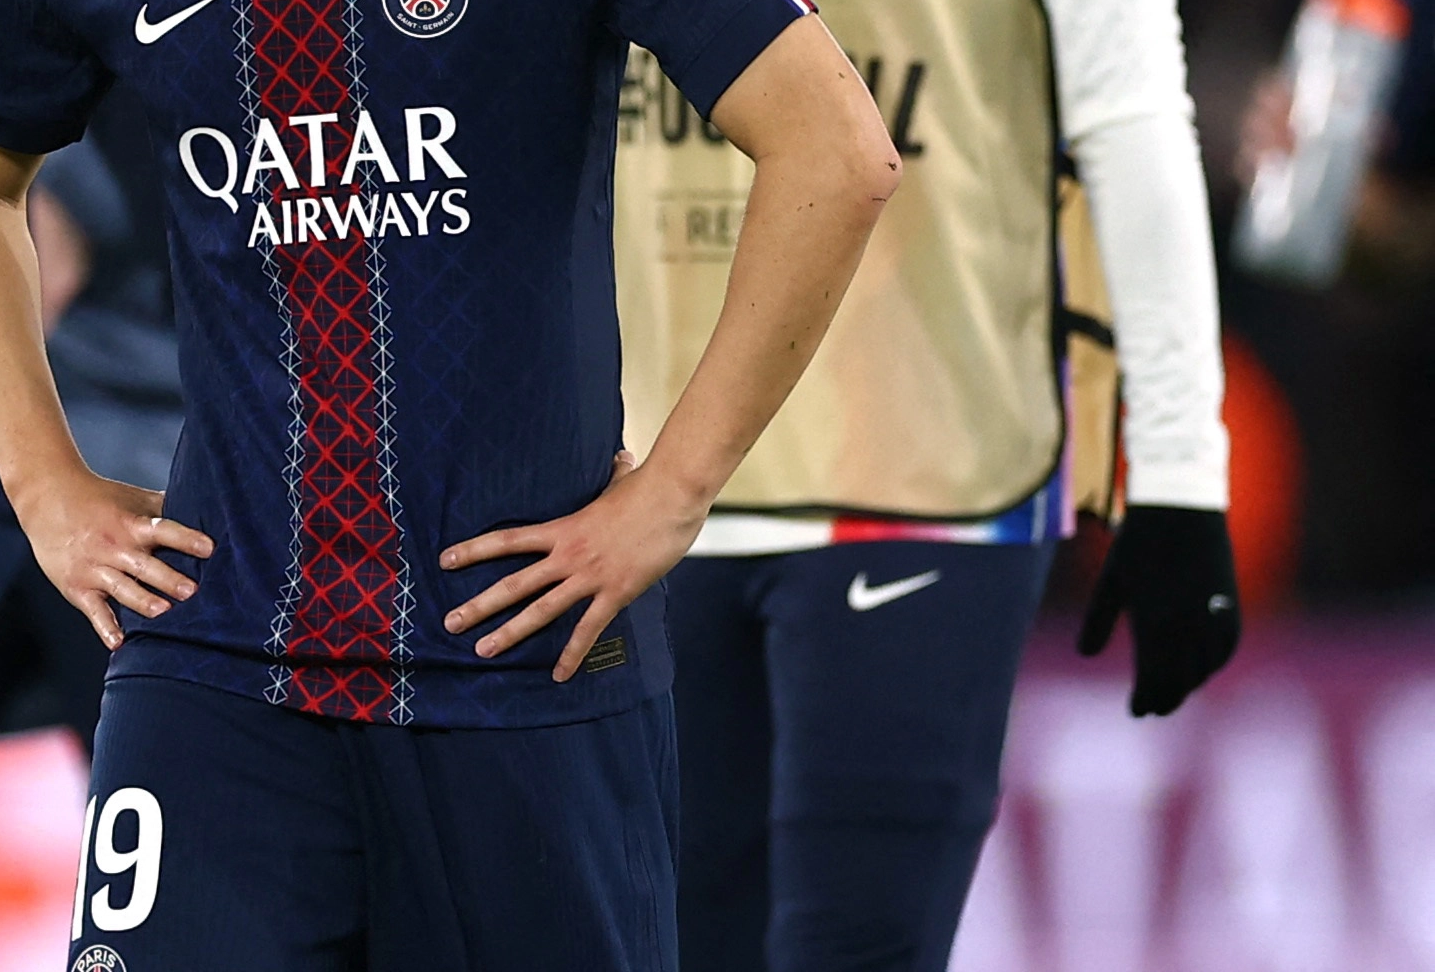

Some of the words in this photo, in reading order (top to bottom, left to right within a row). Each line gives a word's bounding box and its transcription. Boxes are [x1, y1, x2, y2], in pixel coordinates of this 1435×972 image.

[178, 106, 468, 214] QATAR
[247, 188, 471, 248] AIRWAYS
[71, 787, 163, 942] 19
[77, 949, 116, 972] PARIS
